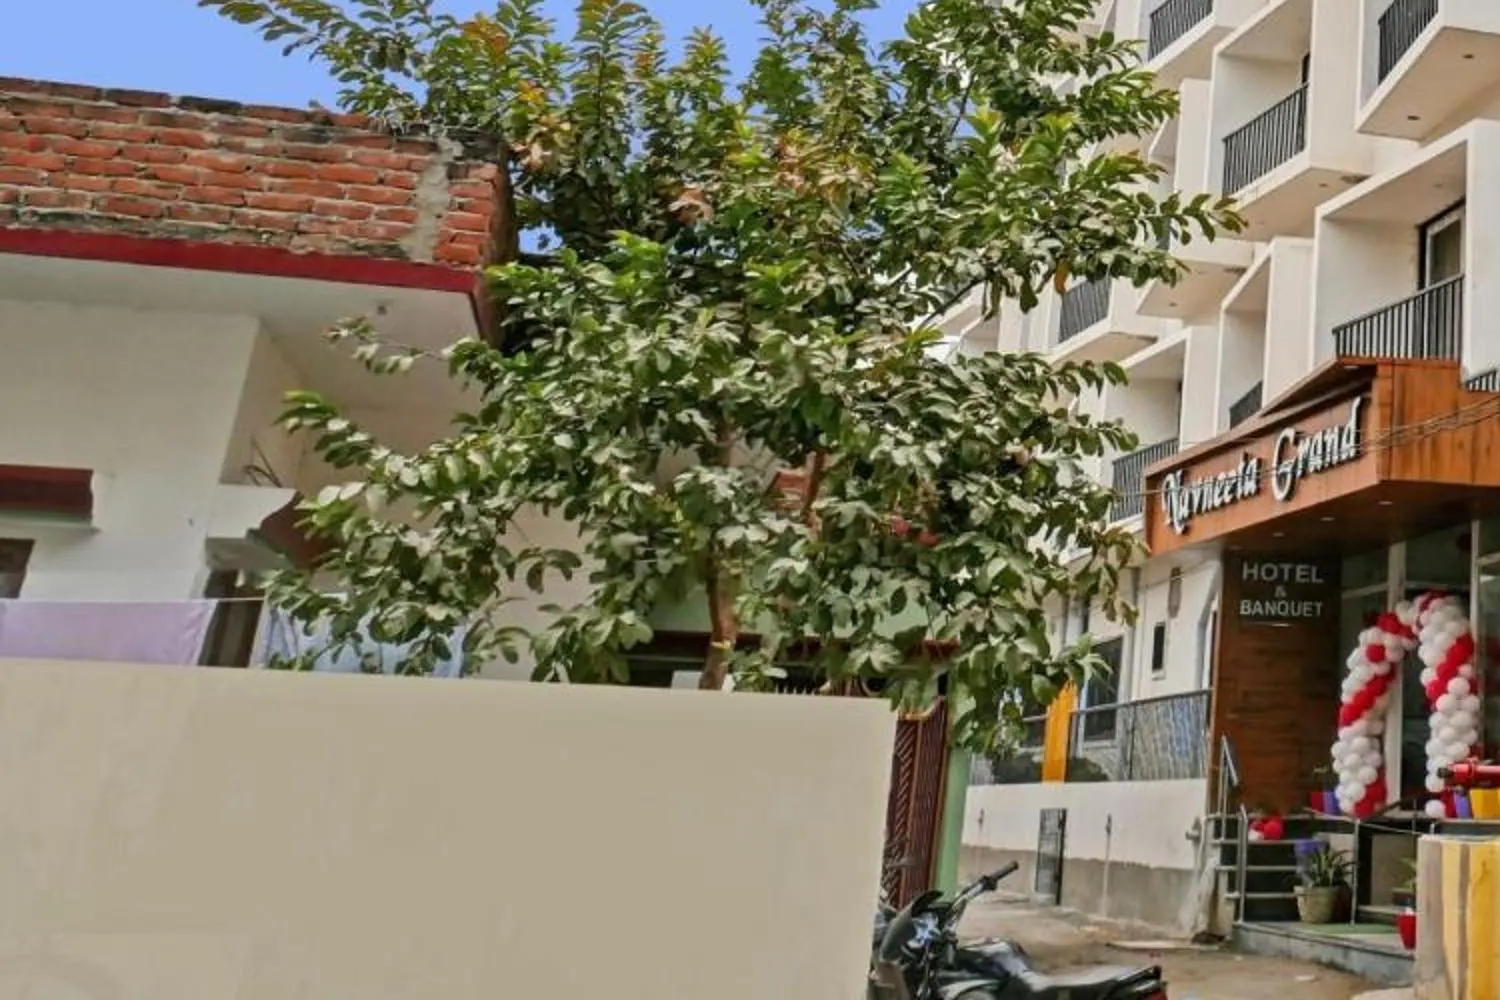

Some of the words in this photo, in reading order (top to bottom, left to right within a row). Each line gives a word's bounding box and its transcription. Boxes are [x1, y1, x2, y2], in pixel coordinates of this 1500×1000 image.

[1271, 395, 1361, 502] Grand
[1242, 561, 1324, 584] HOTEL
[1239, 599, 1323, 618] BANQUET
